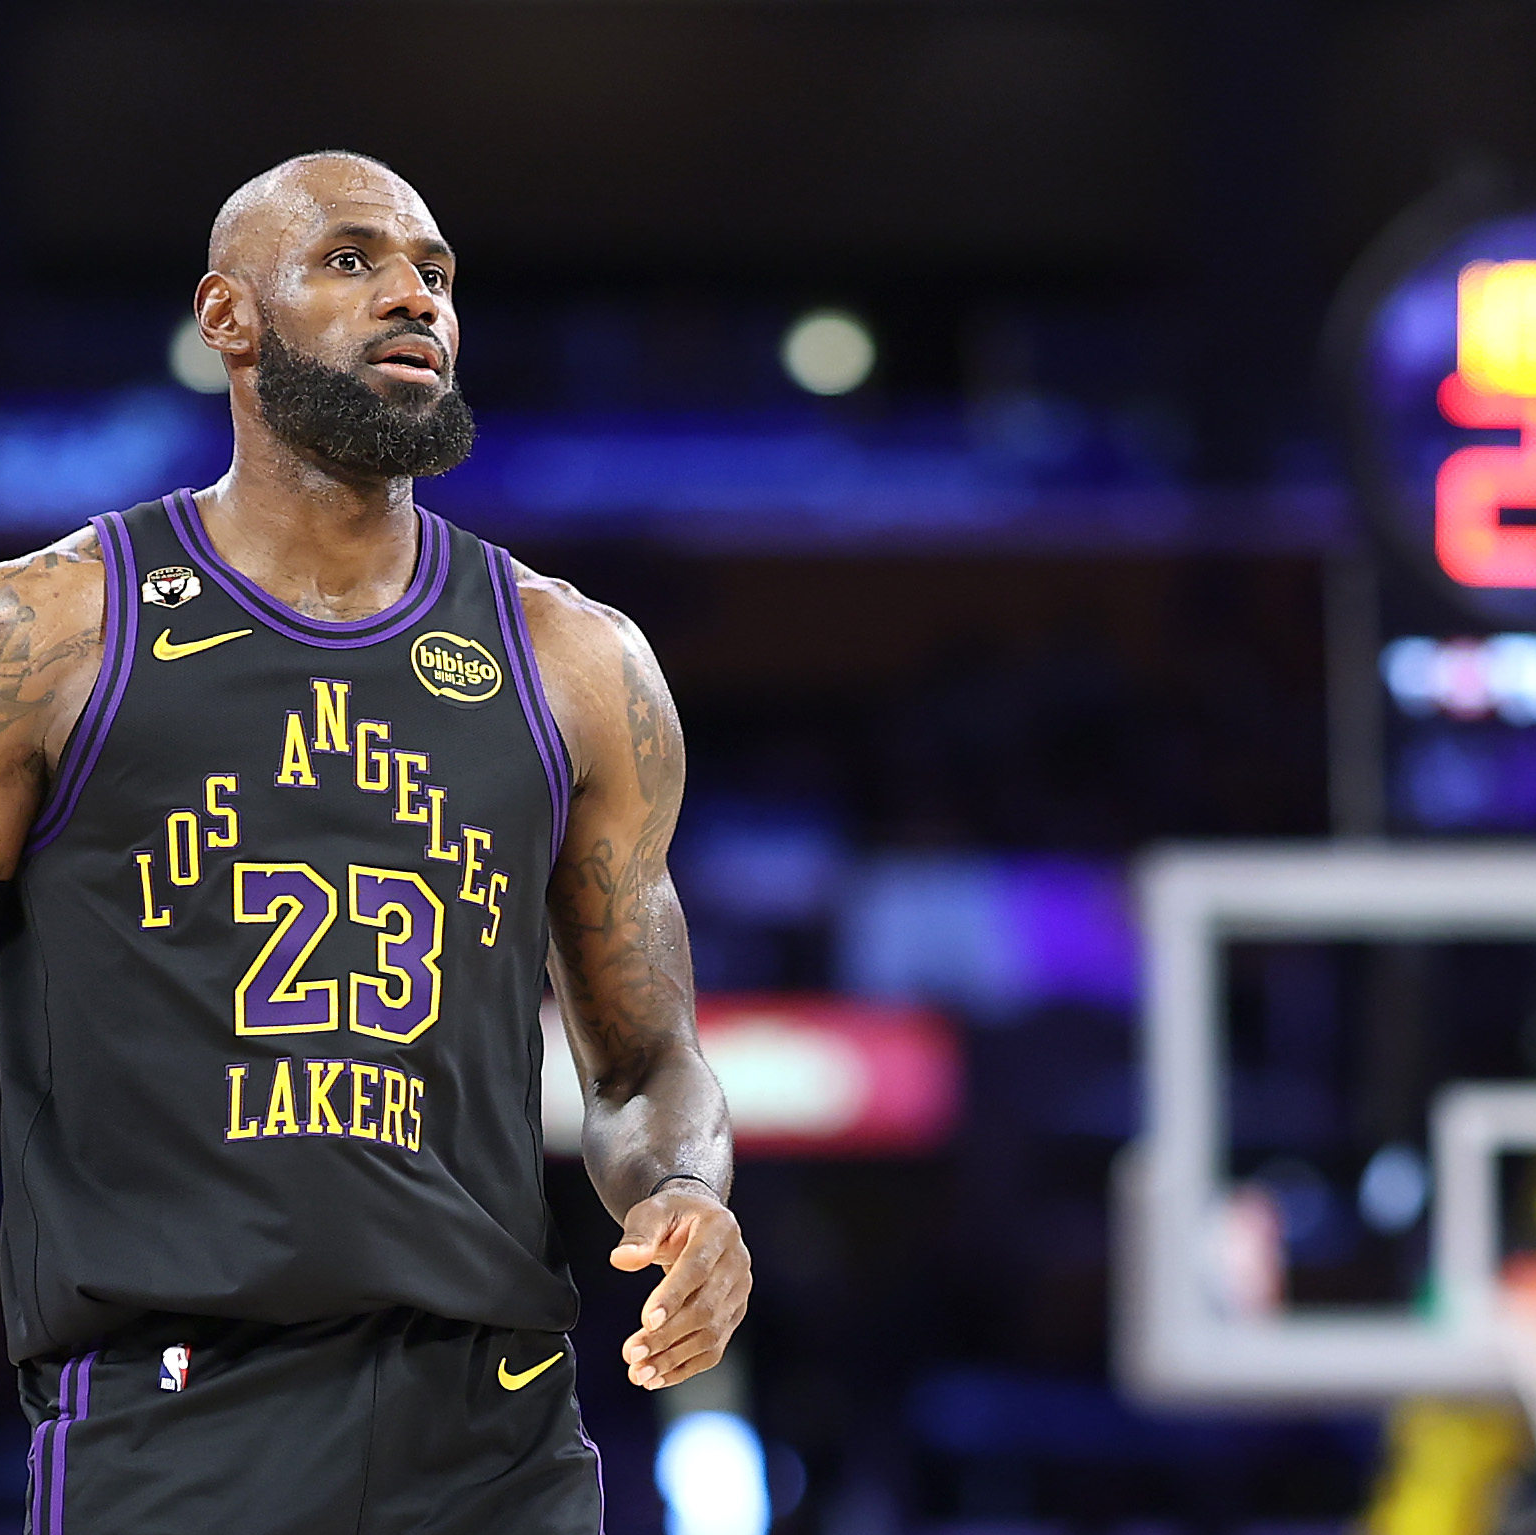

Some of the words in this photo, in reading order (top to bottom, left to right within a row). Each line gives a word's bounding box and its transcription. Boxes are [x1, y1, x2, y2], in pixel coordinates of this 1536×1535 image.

[419, 645, 496, 685] bibigo
[433, 669, 467, 687] 비비고
[133, 773, 240, 931] LOS
[276, 677, 511, 949] ANGELES
[232, 861, 445, 1044] 23
[224, 1057, 426, 1155] LAKERS
